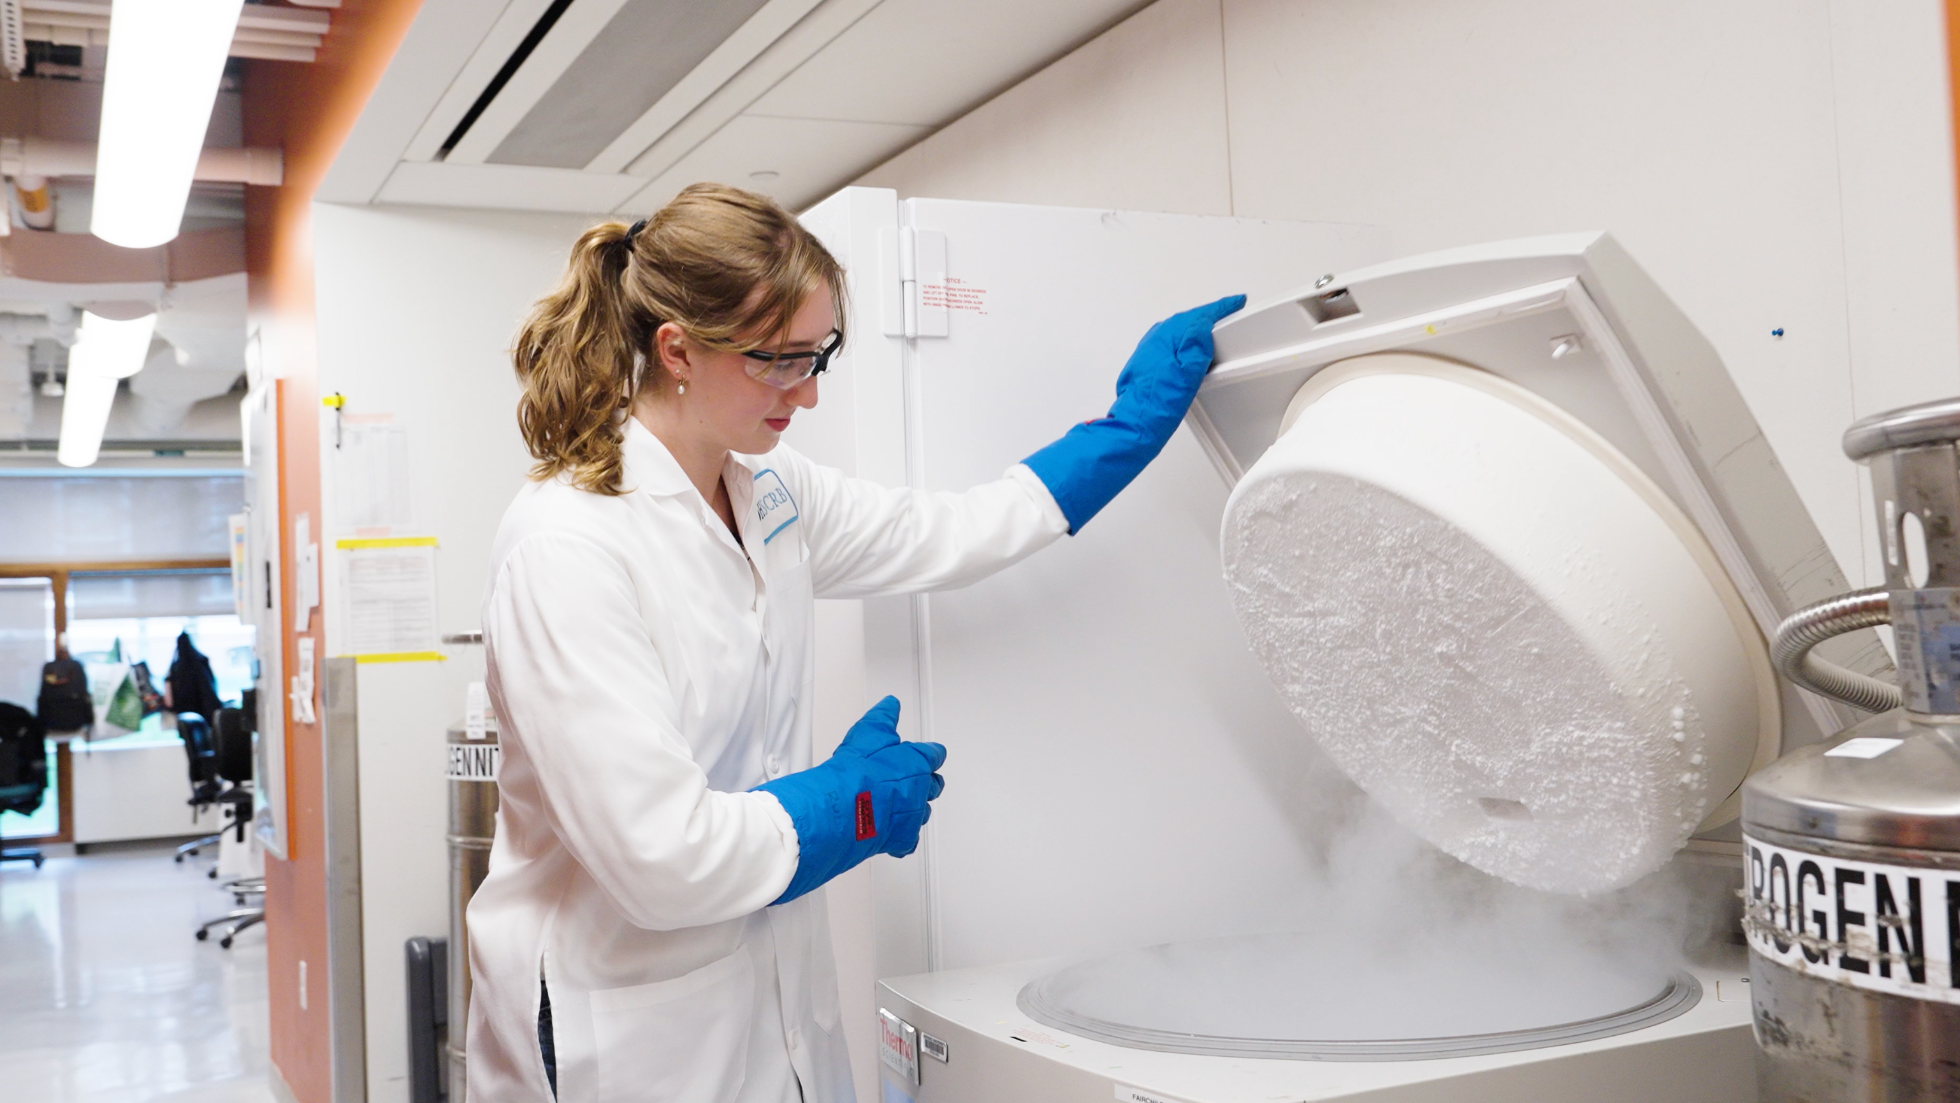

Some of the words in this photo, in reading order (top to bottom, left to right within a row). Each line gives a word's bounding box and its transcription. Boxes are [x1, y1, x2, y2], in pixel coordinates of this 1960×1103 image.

[446, 746, 472, 777] GEN
[1745, 845, 1926, 984] ROGEN
[880, 1018, 913, 1062] Thermo
[1132, 1093, 1164, 1103] FAIRCHI
